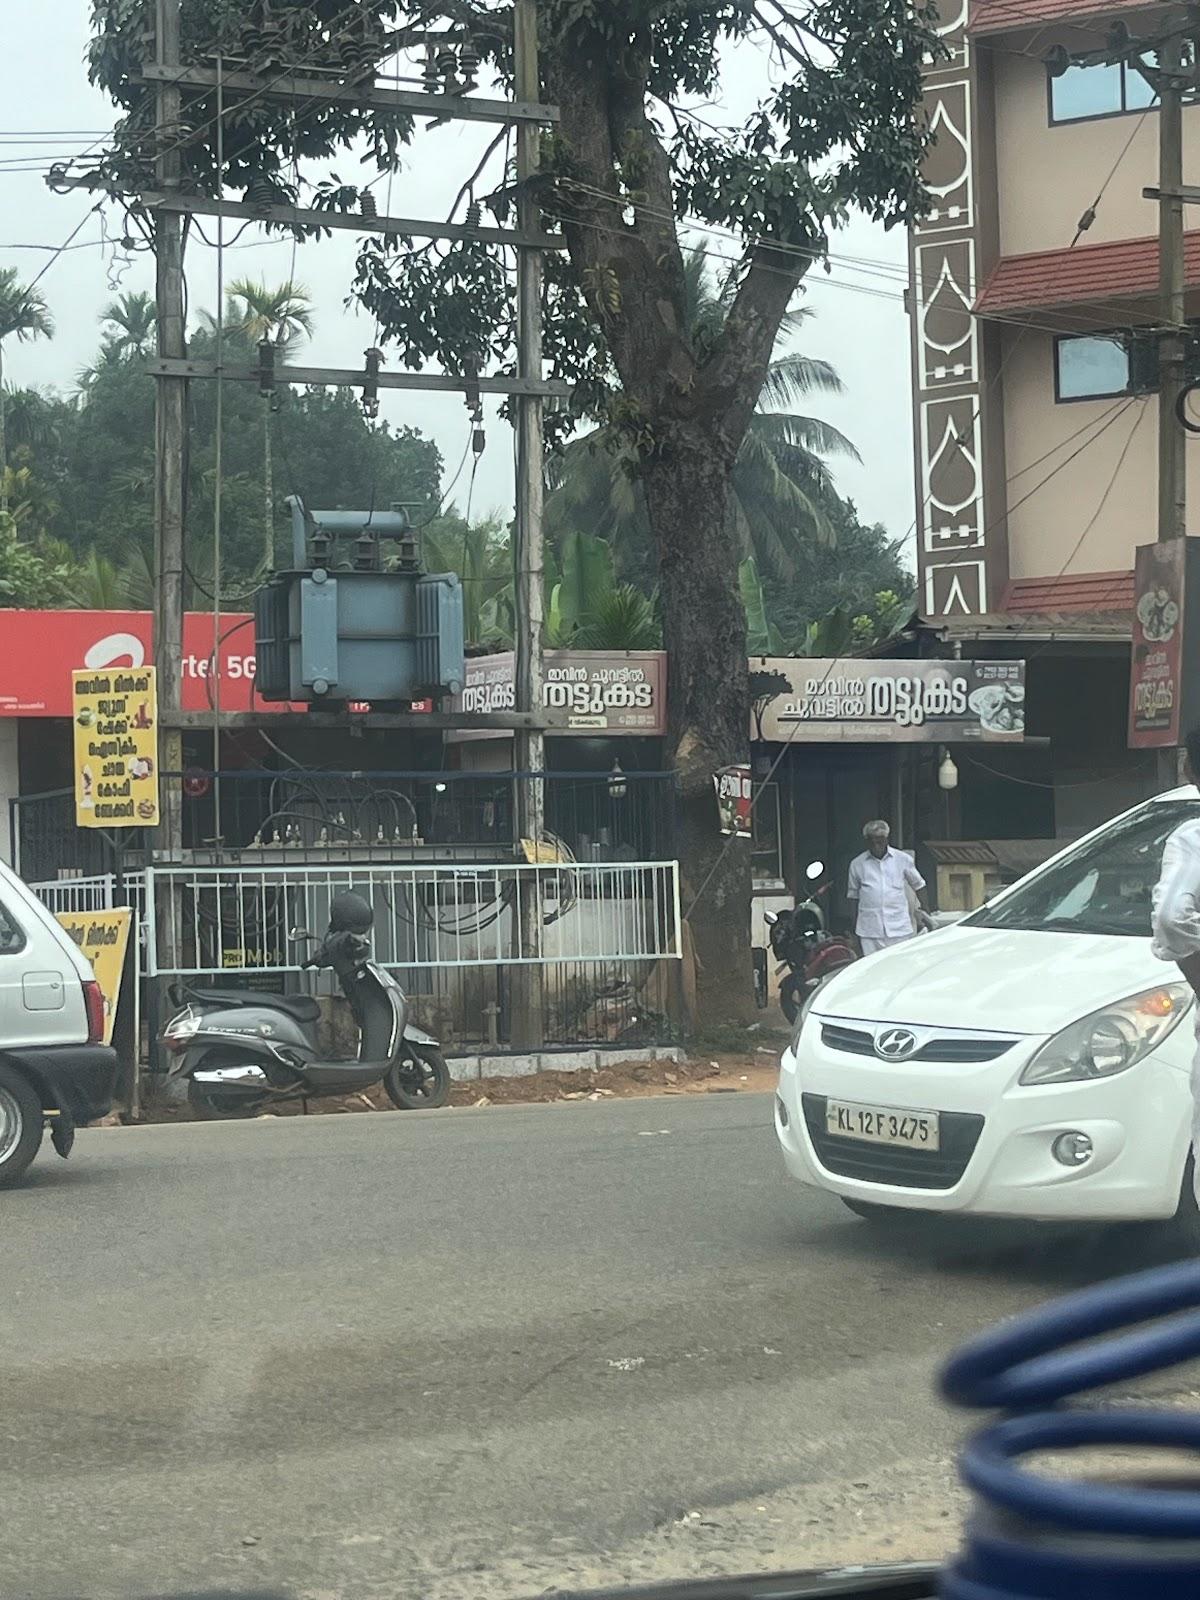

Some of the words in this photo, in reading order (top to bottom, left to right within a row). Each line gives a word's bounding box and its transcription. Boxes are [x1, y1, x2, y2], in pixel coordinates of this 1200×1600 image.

[181, 654, 221, 679] rtel
[547, 667, 588, 682] മാവിൻ
[591, 666, 645, 685] ചുവട്ടിൽ
[542, 682, 653, 714] തട്ടുകട
[805, 676, 865, 697] മാവിൻ
[782, 697, 865, 719] ചുവട്ടിൽ
[867, 676, 968, 727] തട്ടുകട
[837, 1106, 855, 1132] KL
[889, 1115, 928, 1142] 3475
